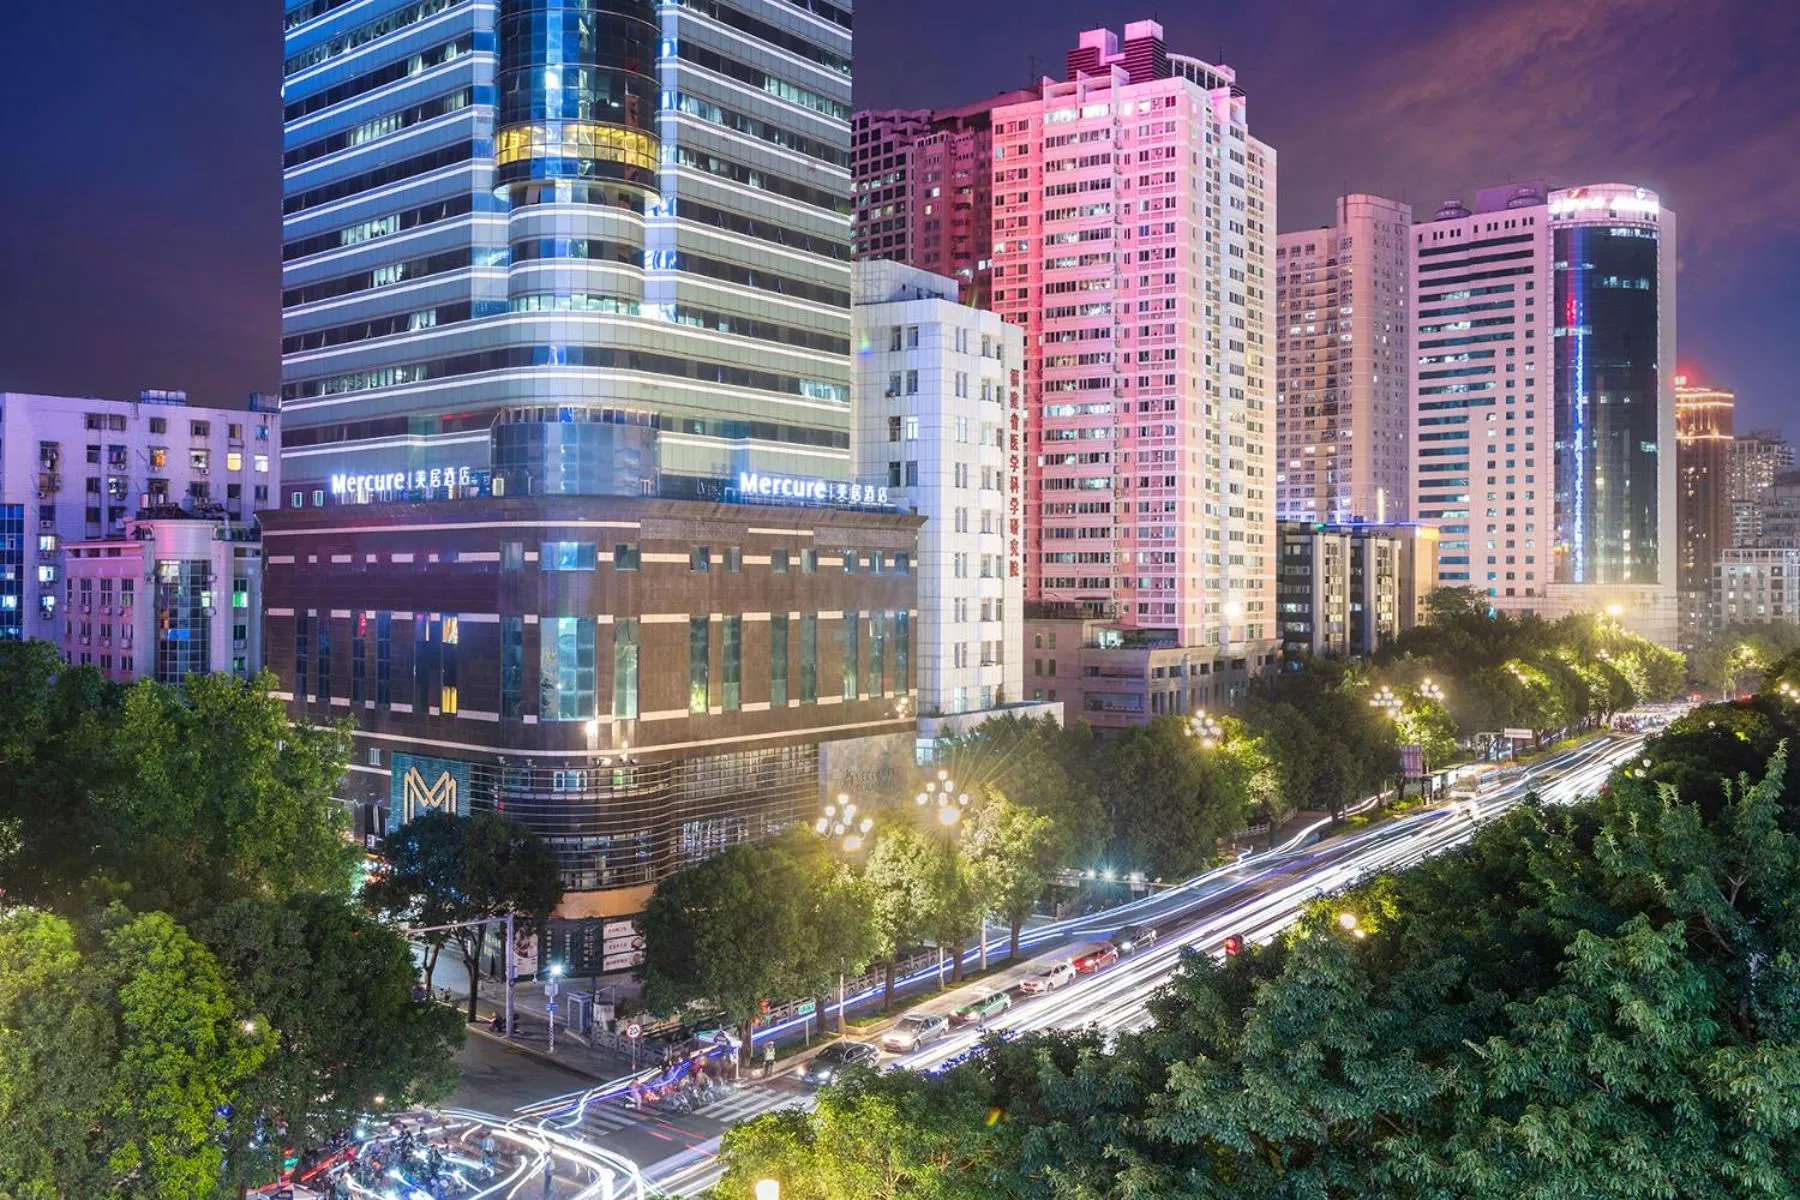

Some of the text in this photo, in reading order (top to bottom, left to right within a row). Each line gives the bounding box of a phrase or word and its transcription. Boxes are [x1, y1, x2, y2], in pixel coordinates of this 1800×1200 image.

[331, 467, 470, 494] Mercure 美居酒店
[740, 472, 827, 499] Mercure
